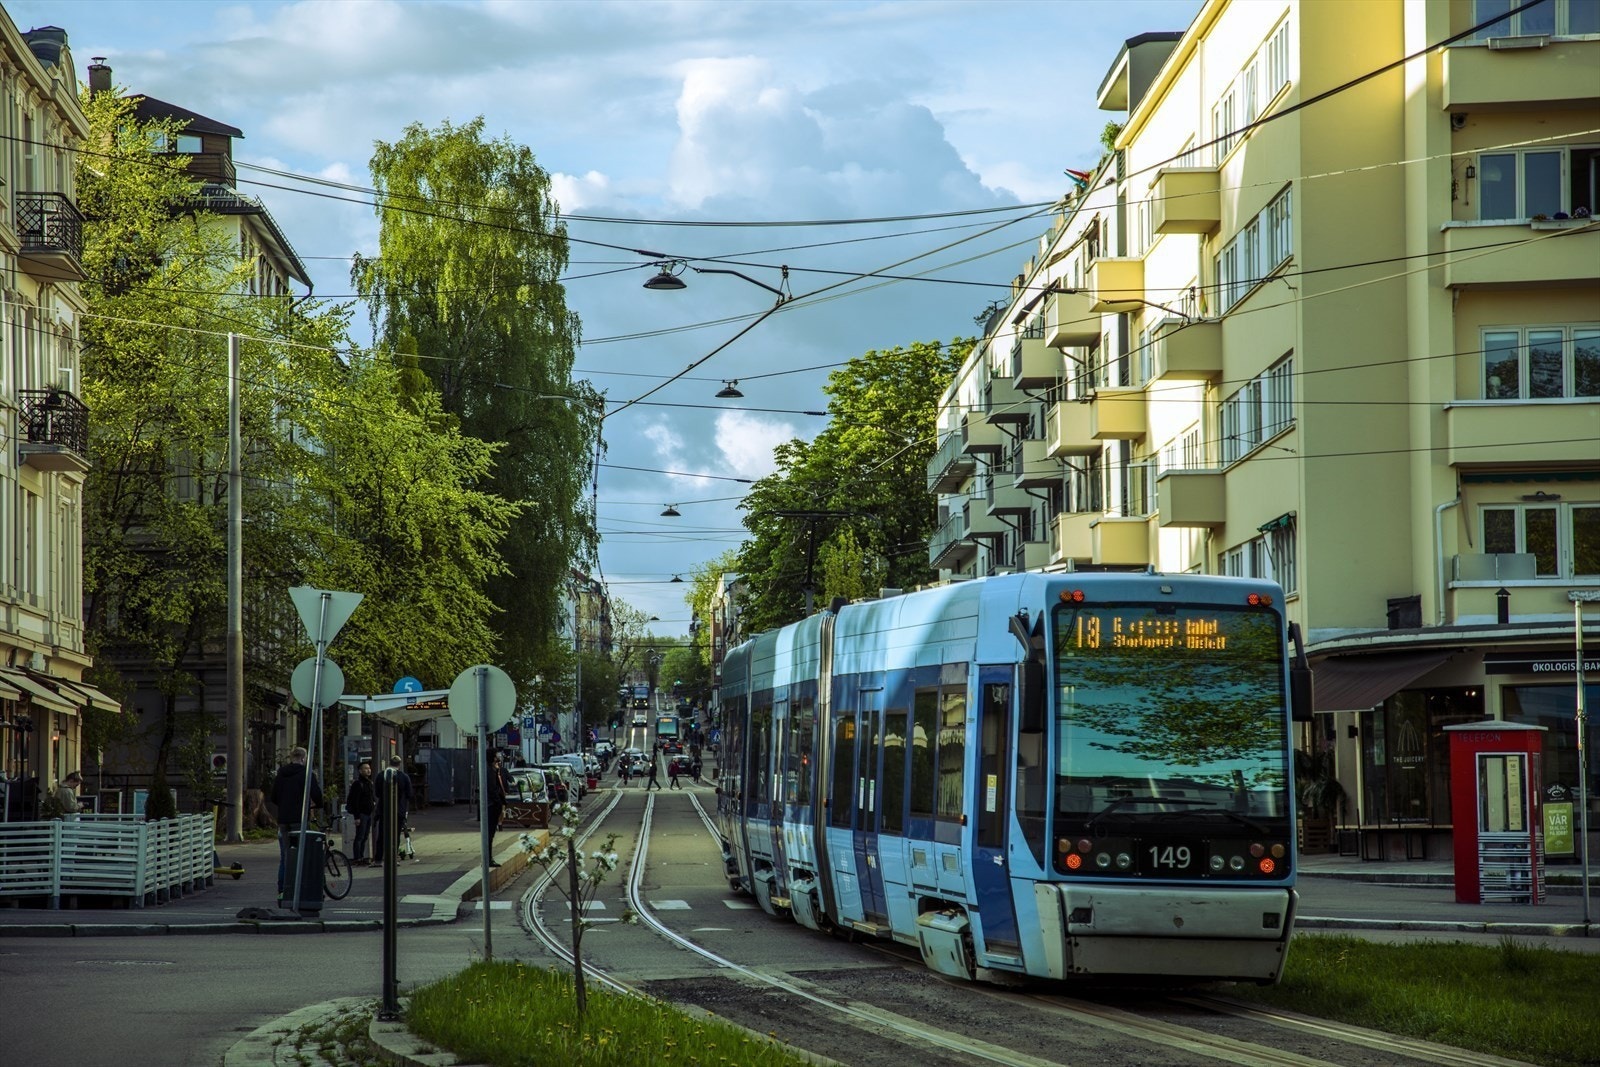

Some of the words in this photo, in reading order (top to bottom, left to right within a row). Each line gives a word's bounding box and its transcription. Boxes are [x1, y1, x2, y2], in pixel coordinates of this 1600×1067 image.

[1532, 662, 1583, 672] ØKOLOGIS
[1458, 733, 1501, 742] TELEFON
[1549, 813, 1567, 825] VÅR
[1149, 846, 1191, 868] 149
